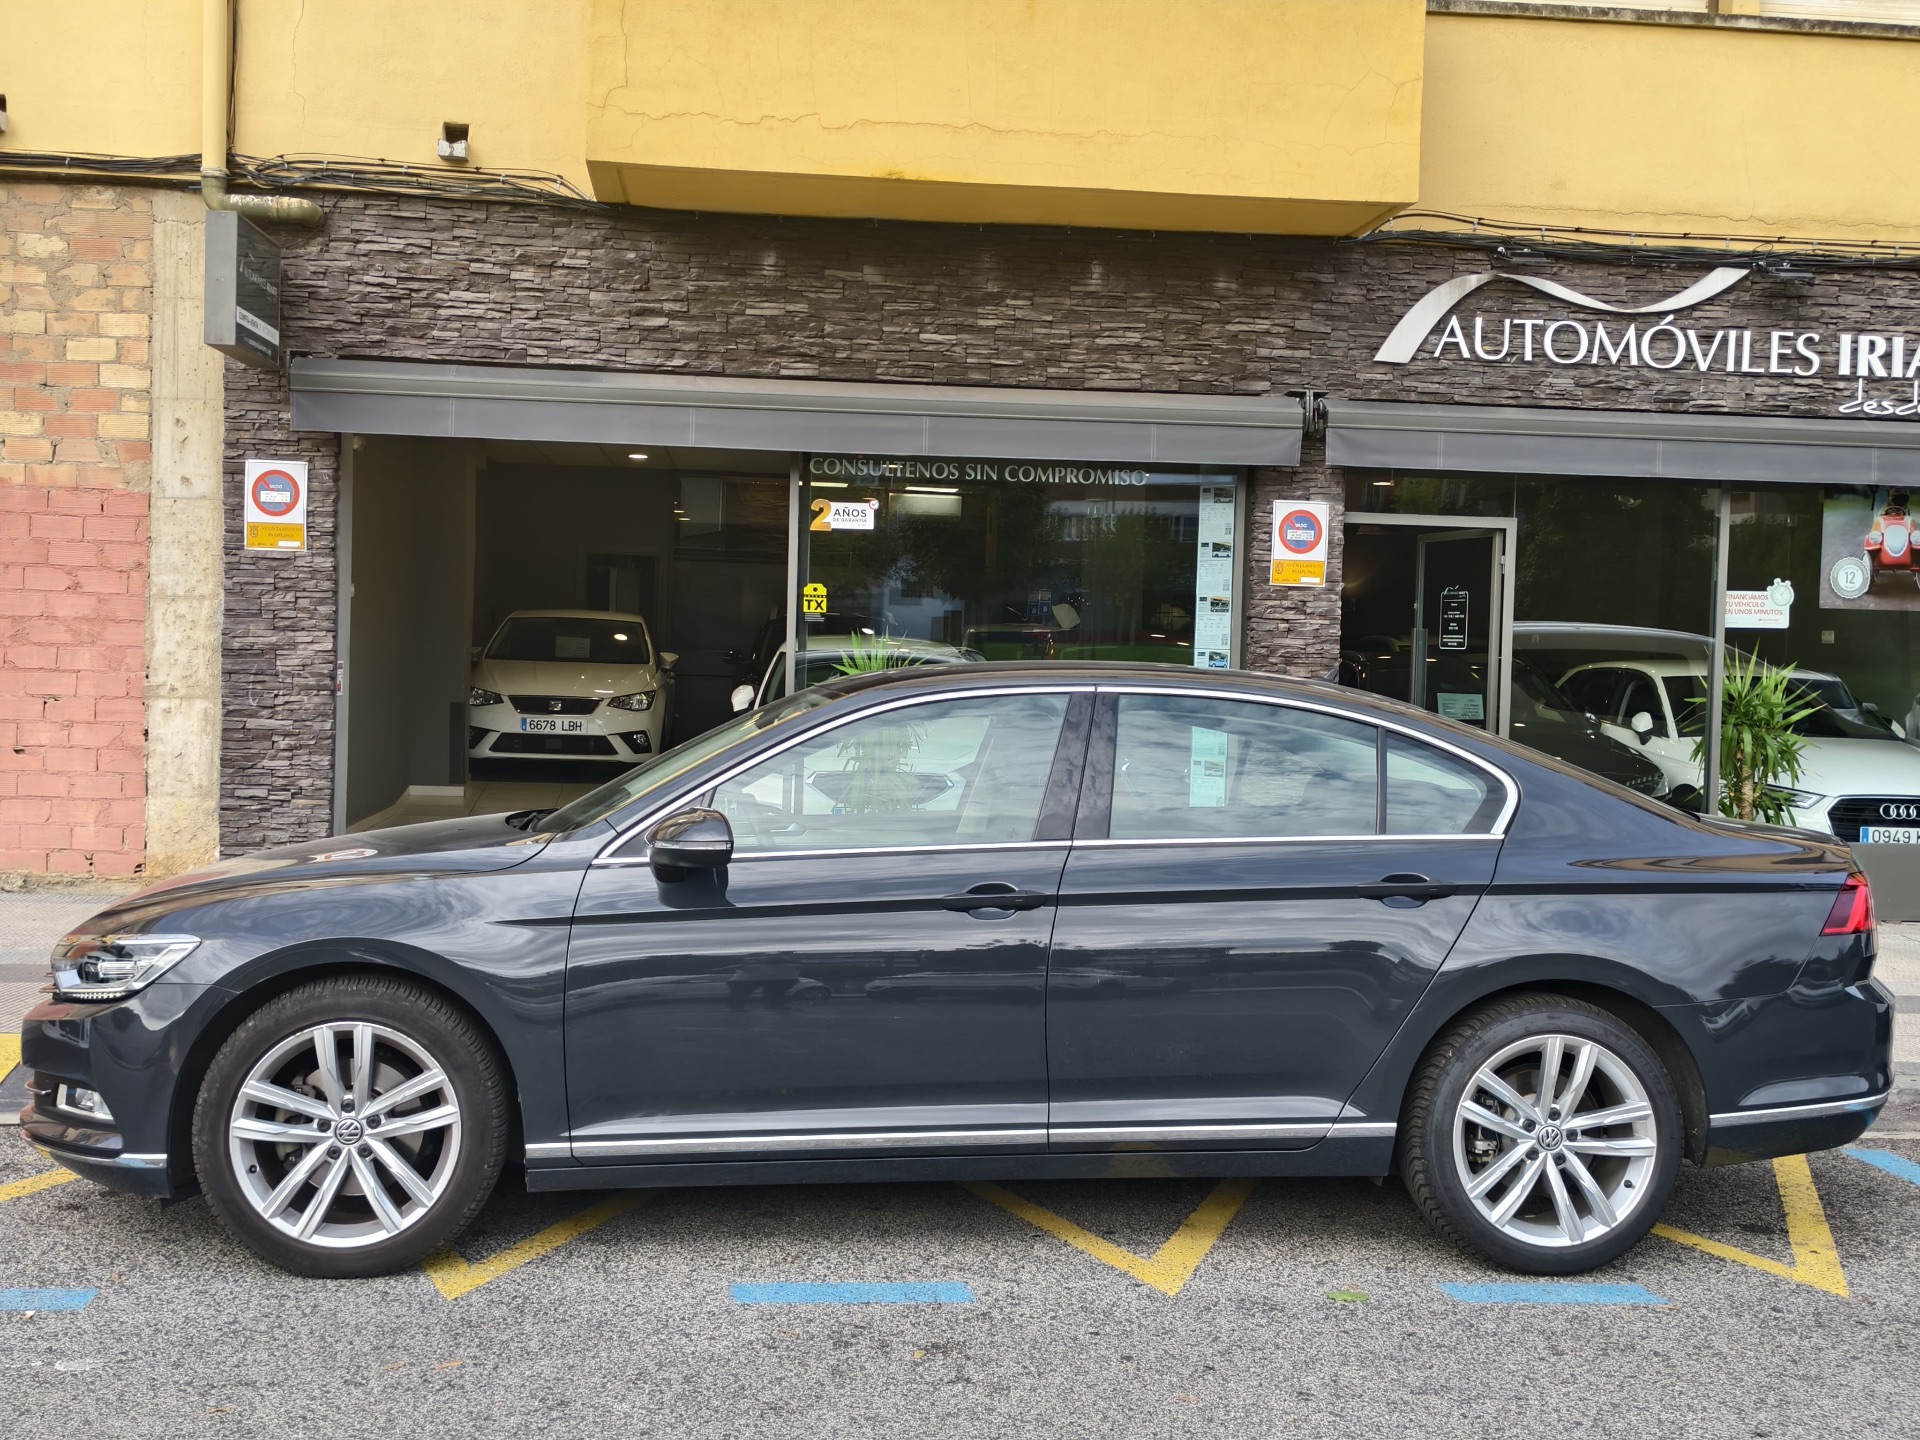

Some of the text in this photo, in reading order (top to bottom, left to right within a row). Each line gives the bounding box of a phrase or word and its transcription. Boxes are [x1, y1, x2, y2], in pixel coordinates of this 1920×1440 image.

[1433, 314, 1820, 376] AUTOMÓVILES
[1838, 378, 1920, 416] desd
[809, 457, 1147, 486] CONSULTENOS SIN COMPROMISO
[810, 498, 832, 532] 2
[833, 506, 867, 518] AÑOS
[1844, 571, 1856, 584] 12
[805, 599, 825, 611] TX
[529, 720, 582, 731] 6678 LBH
[1872, 829, 1911, 844] 0949
